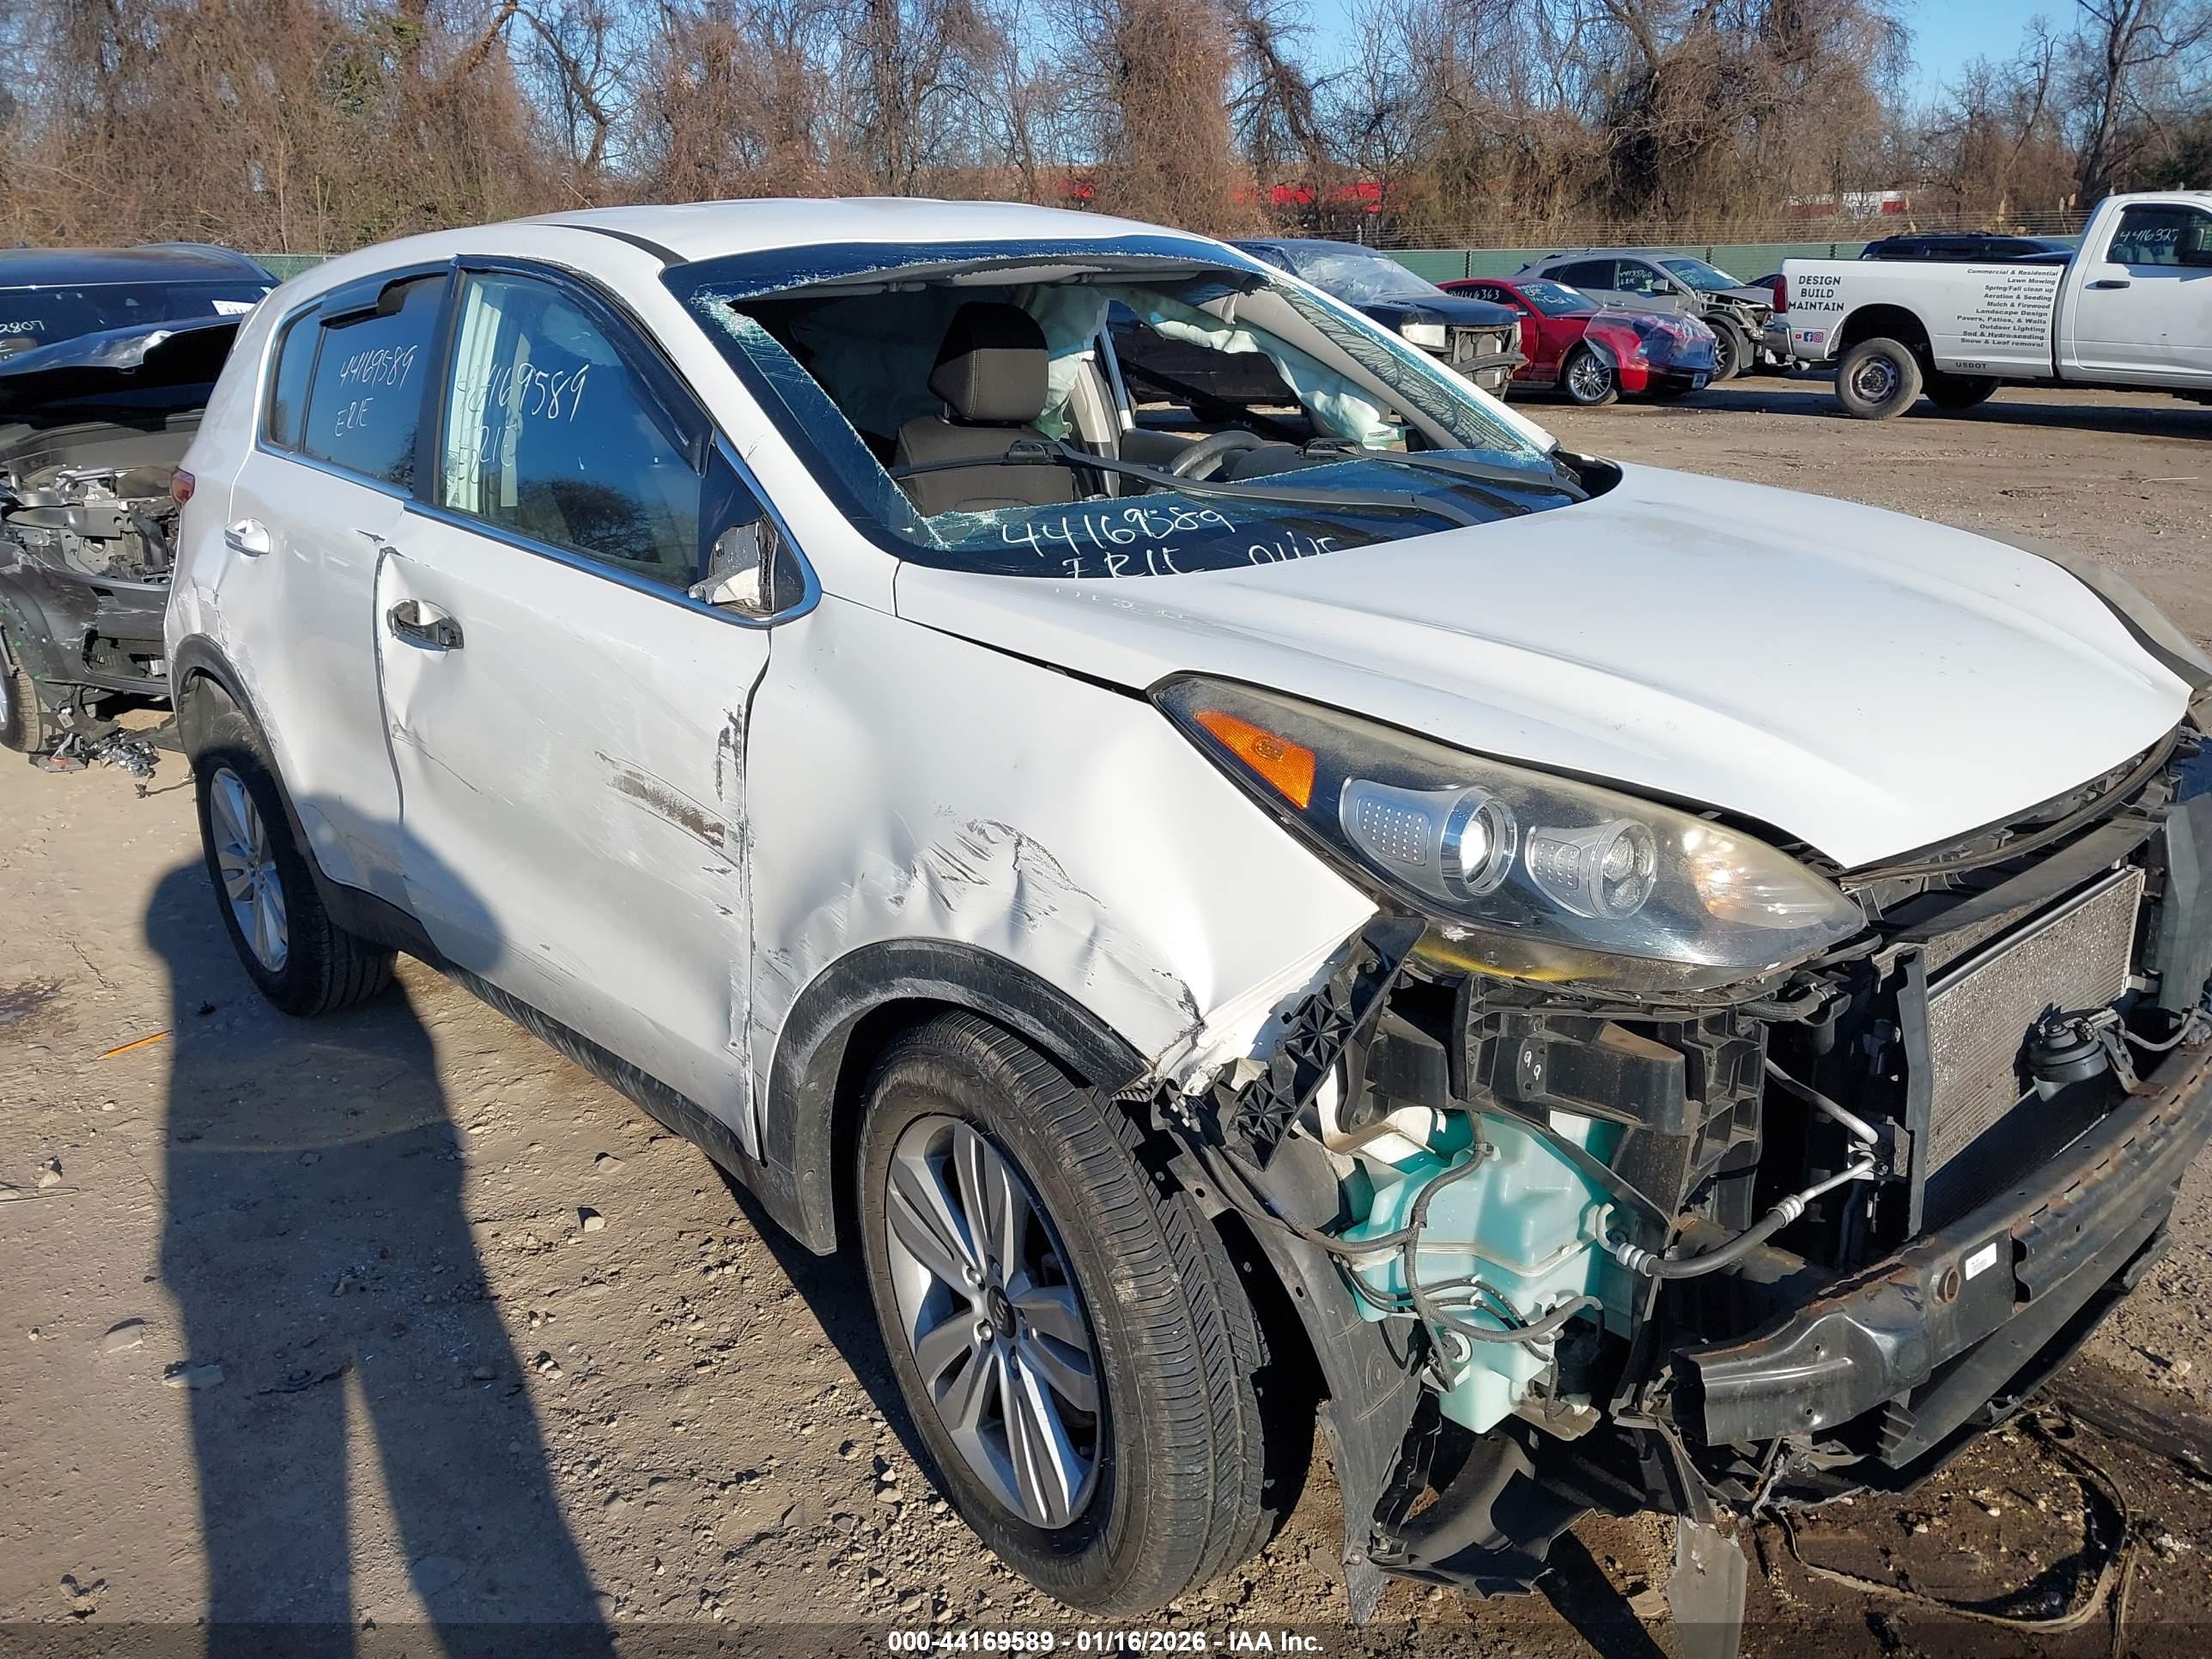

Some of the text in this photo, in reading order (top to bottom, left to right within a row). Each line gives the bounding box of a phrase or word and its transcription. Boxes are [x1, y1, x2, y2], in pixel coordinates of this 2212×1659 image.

[1799, 276, 1841, 285] DESIGN
[1801, 289, 1834, 298] BUILD
[1788, 301, 1844, 311] MAINTAIN
[340, 345, 418, 390] 44169589
[335, 398, 374, 437] ERIE
[1002, 507, 1236, 557] 44169589
